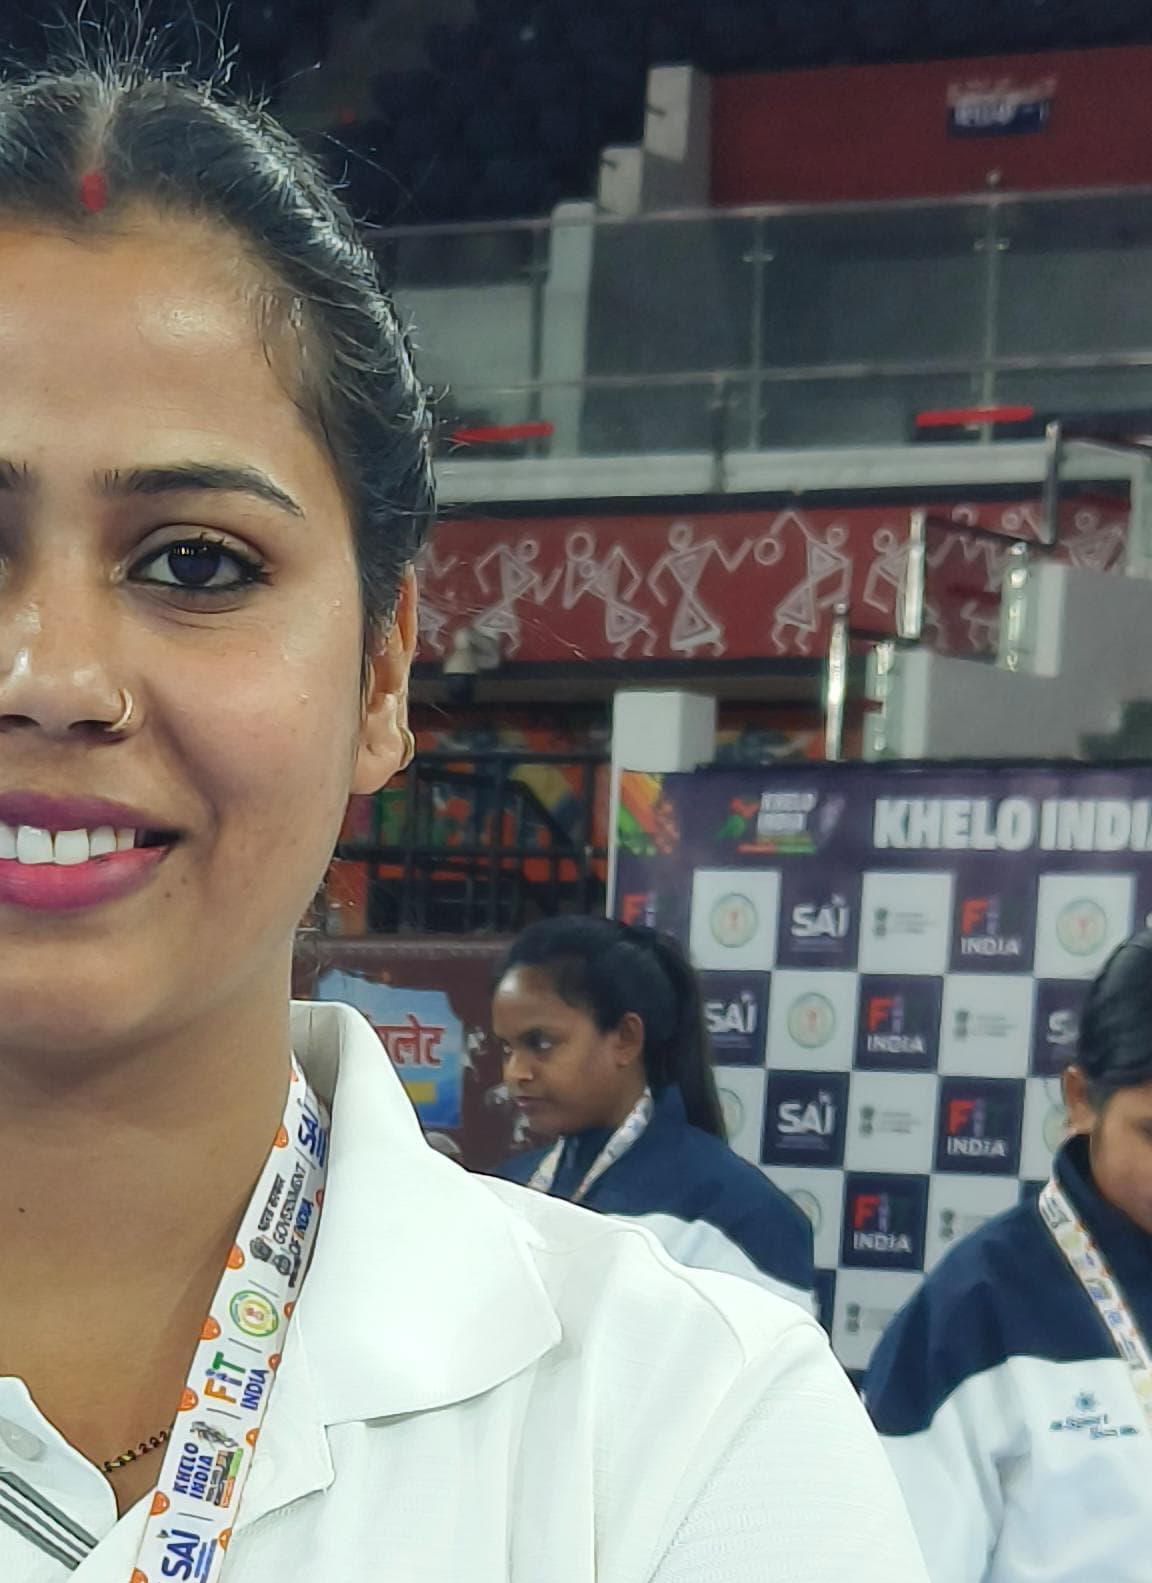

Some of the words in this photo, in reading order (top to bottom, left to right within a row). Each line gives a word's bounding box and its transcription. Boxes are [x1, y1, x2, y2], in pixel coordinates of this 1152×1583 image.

[873, 797, 1034, 850] KHELO
[1039, 799, 1152, 851] INDI
[791, 901, 849, 938] SAI
[960, 936, 1022, 957] INDIA
[704, 1001, 758, 1035] SAI
[866, 1034, 927, 1054] INDIA
[298, 1103, 319, 1155] SAI
[776, 1102, 836, 1136] SAI
[946, 1137, 1007, 1158] INDIA
[851, 1231, 914, 1253] INDIA
[240, 1369, 269, 1411] INDIA
[173, 1442, 199, 1494] KHELO
[189, 1455, 214, 1500] INDIA
[161, 1528, 200, 1581] SAI
